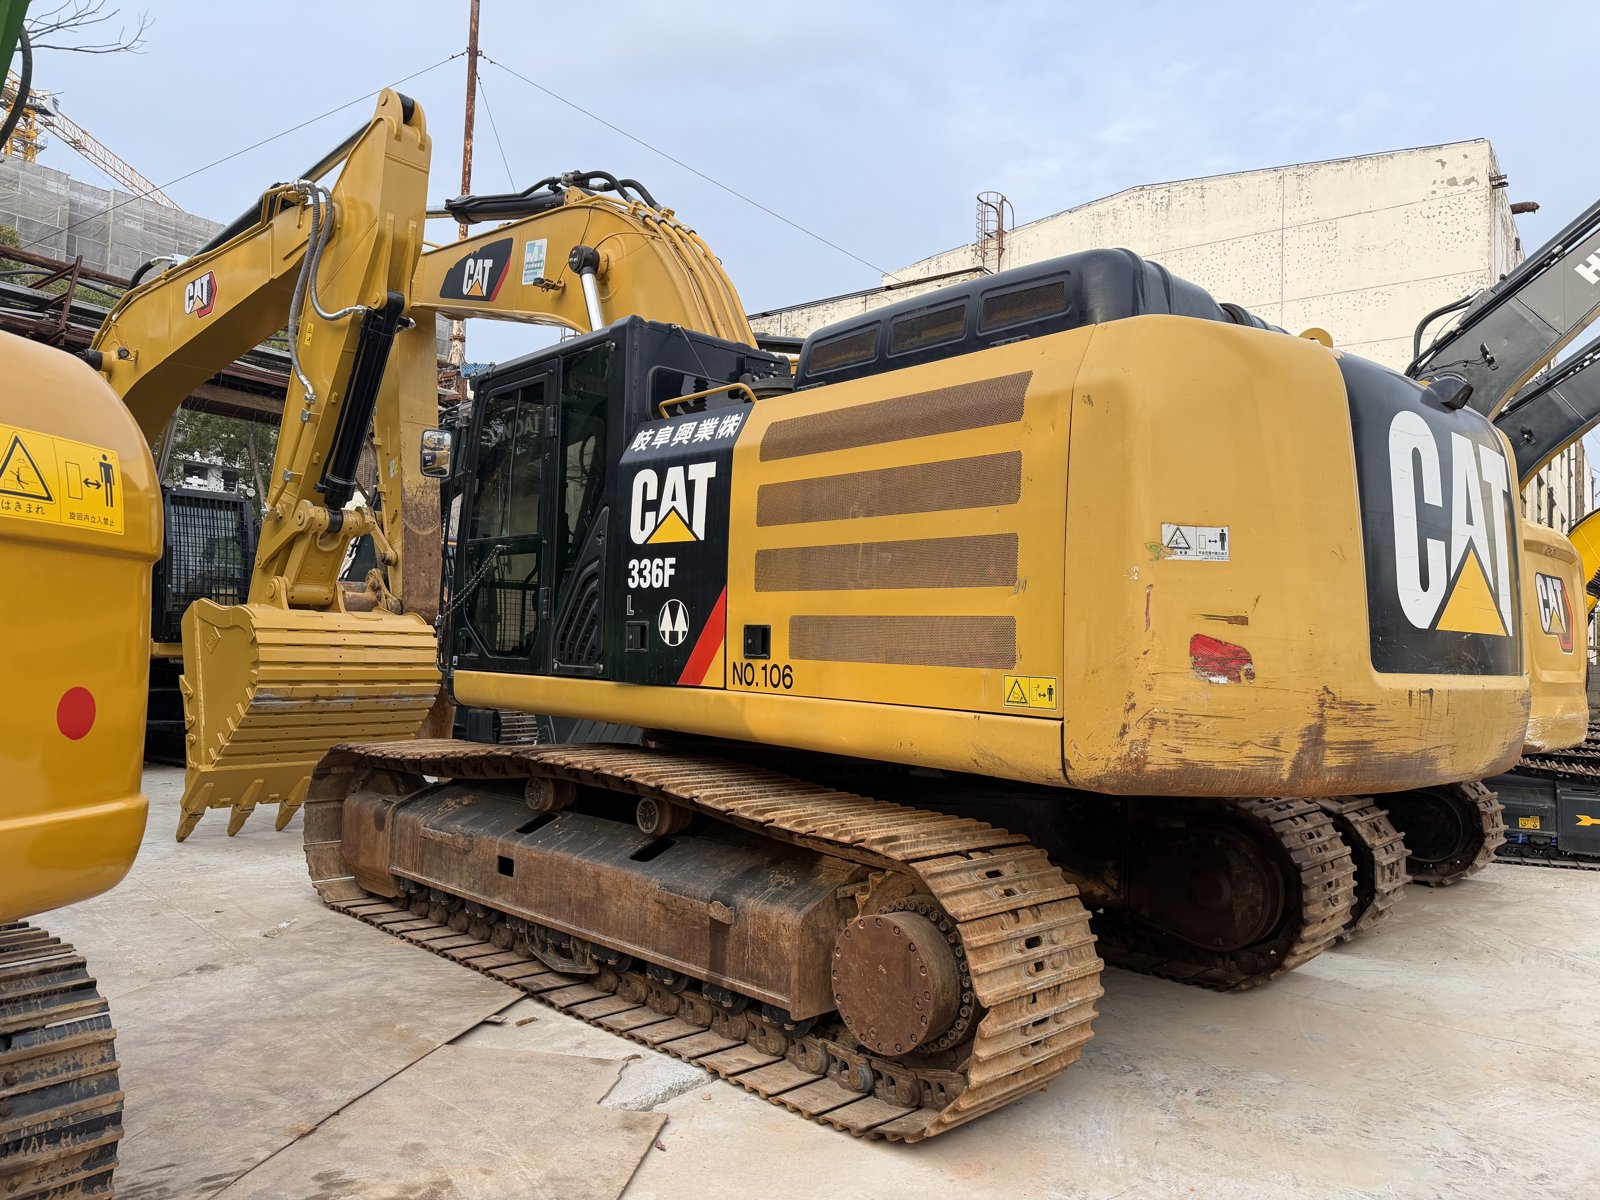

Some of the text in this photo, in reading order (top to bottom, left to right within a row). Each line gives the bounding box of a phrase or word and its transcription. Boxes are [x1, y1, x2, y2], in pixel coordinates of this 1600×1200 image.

[463, 258, 493, 297] CAT
[1574, 247, 1600, 285] H
[184, 273, 210, 315] CAT
[630, 462, 717, 544] CAT
[1389, 411, 1513, 637] CAT
[628, 557, 676, 588] 336F
[1535, 573, 1566, 634] CAT
[733, 661, 793, 689] NO.106
